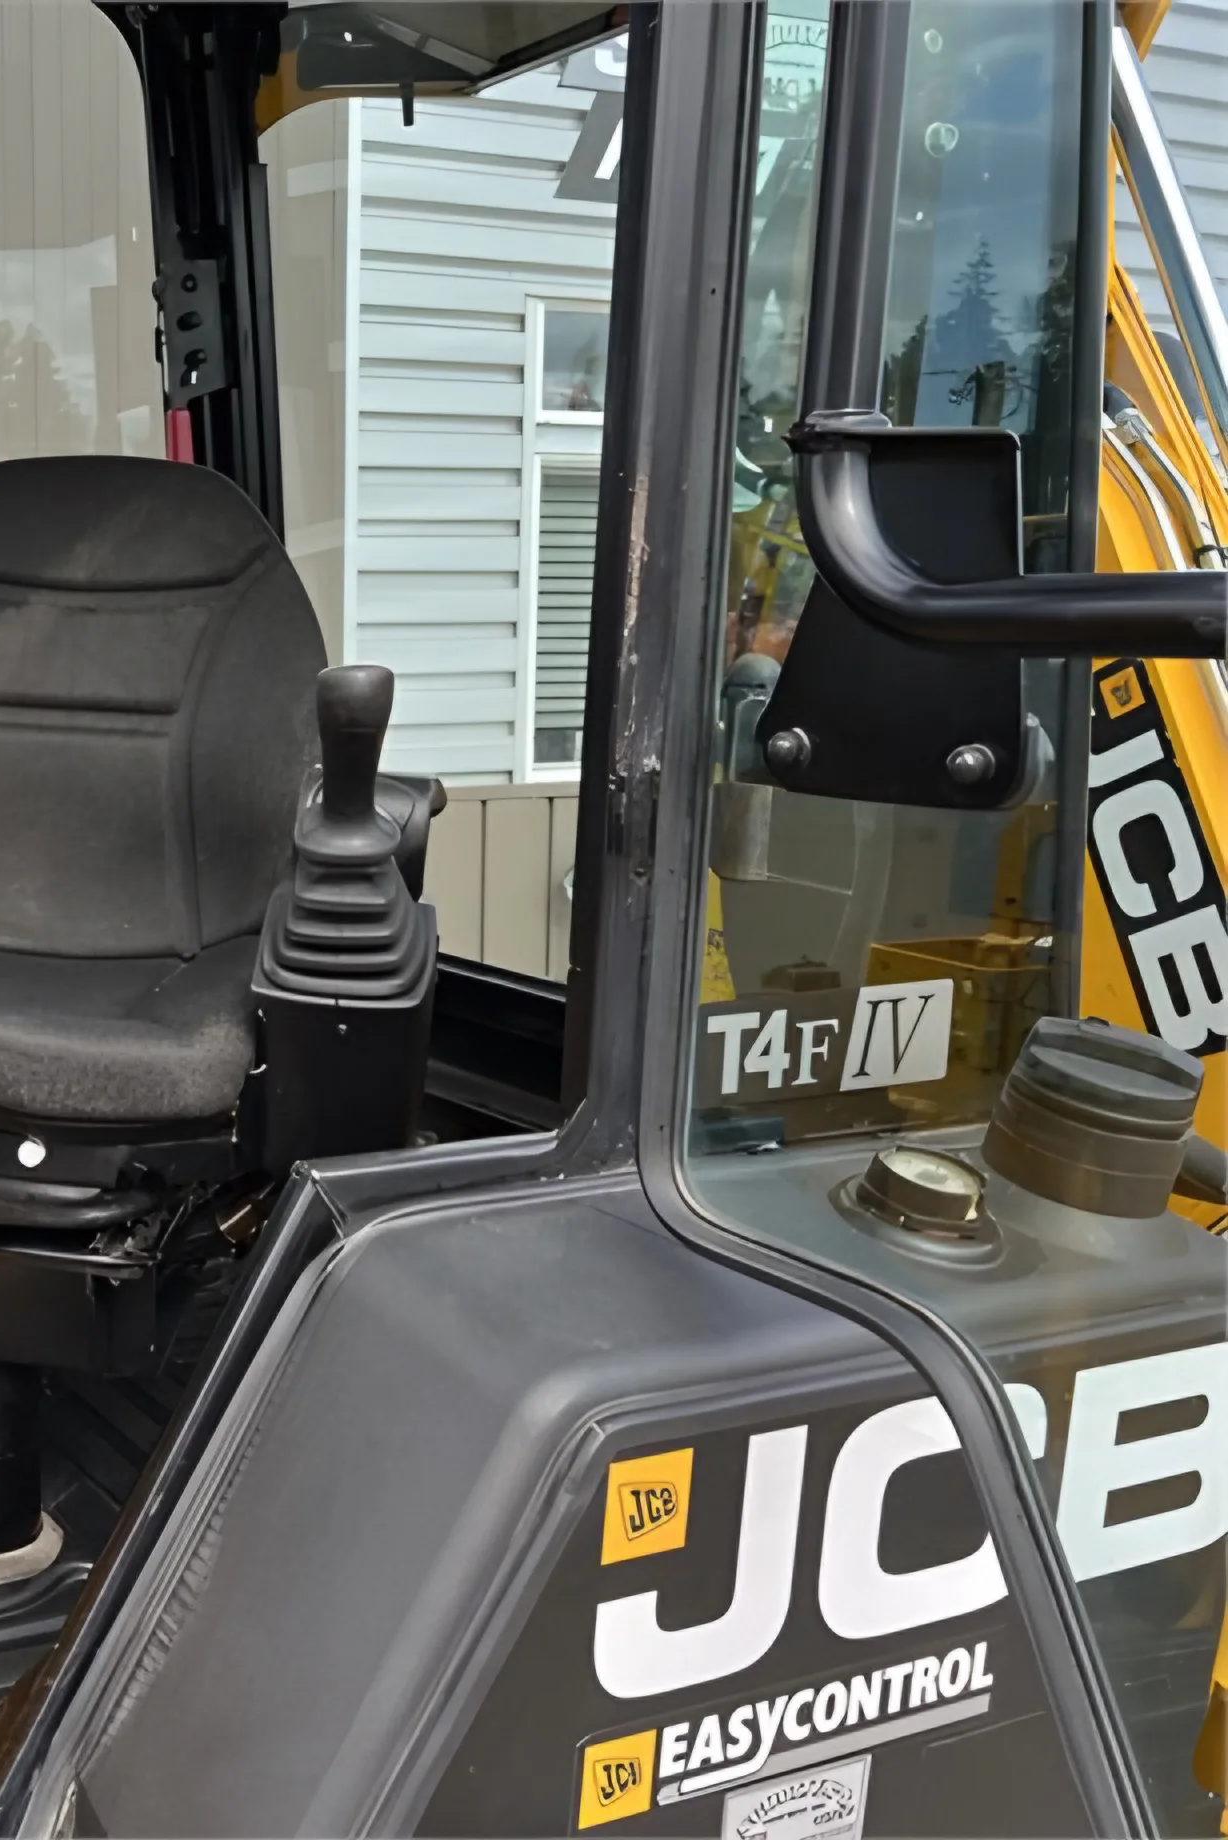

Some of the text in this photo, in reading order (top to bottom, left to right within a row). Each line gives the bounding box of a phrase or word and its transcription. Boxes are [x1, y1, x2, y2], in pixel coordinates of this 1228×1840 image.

[1087, 728, 1228, 1052] JCB
[594, 1343, 1228, 1698] JCB
[629, 1488, 676, 1533] JCB
[658, 1642, 994, 1781] EASYCONTROL
